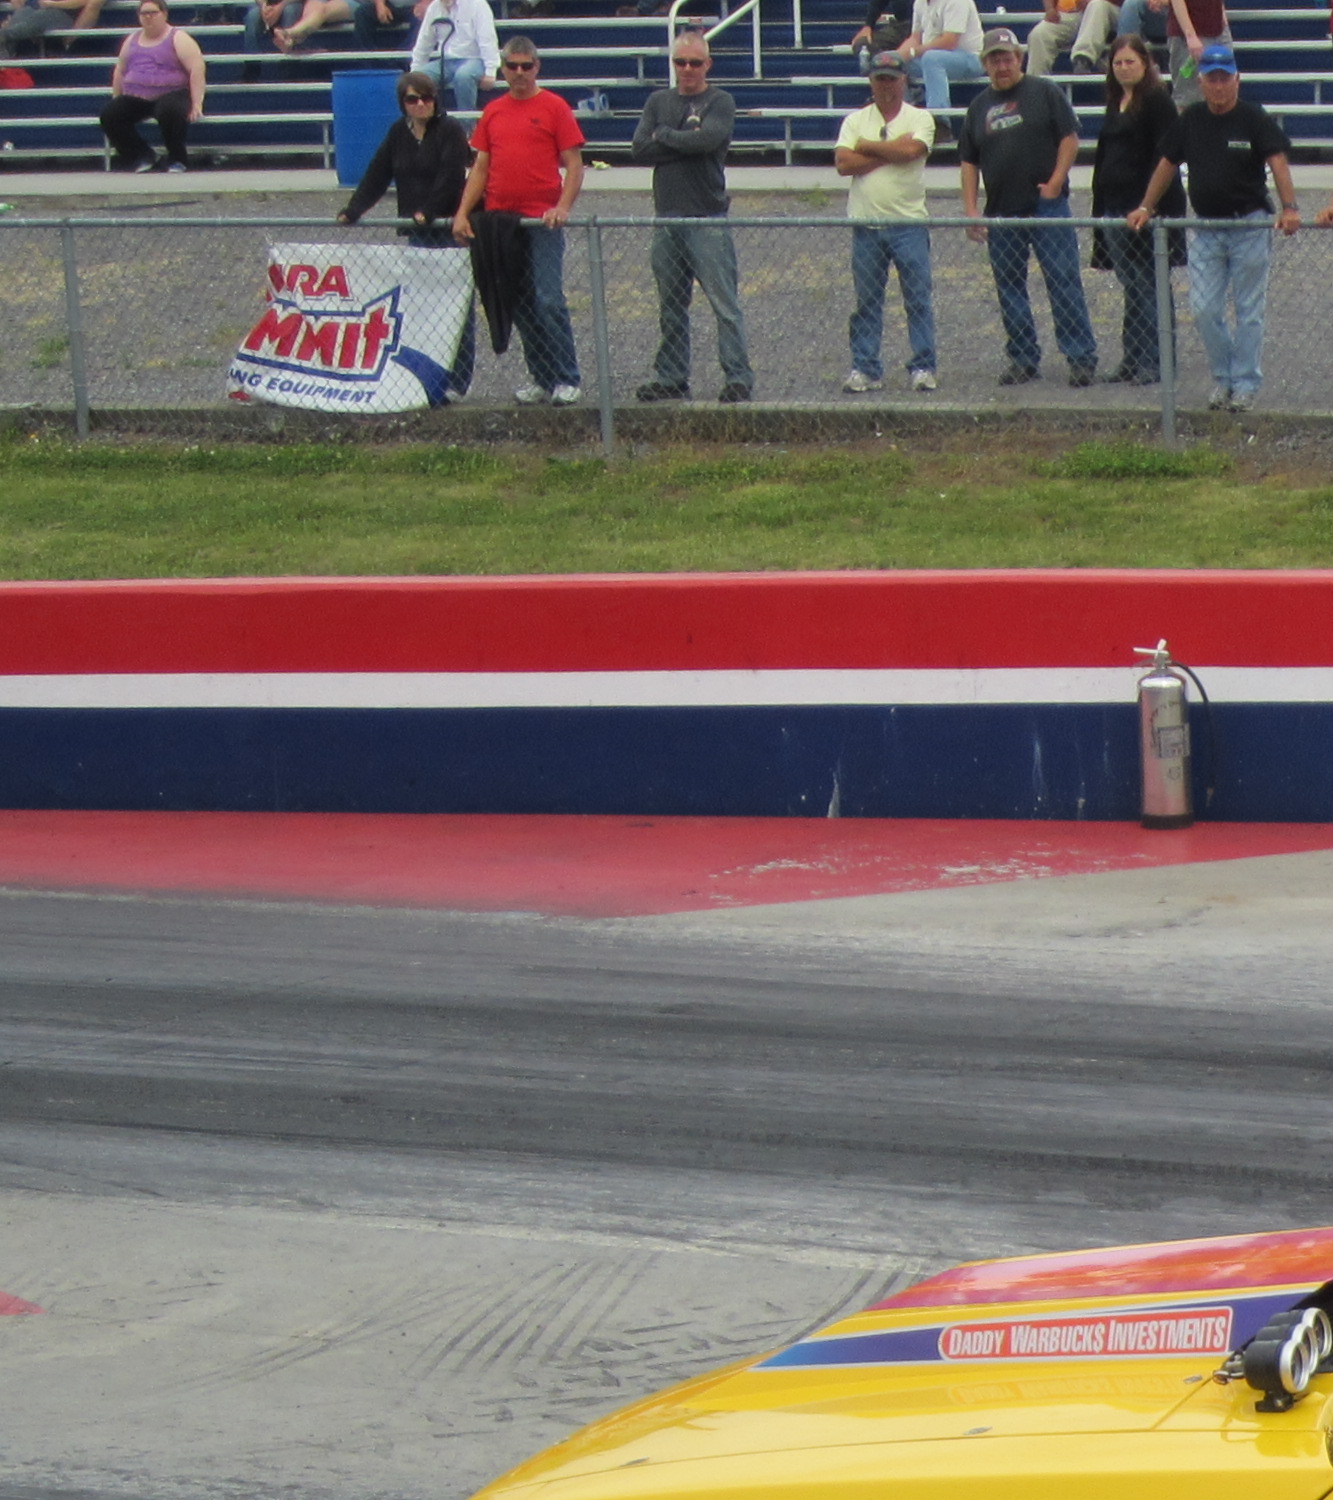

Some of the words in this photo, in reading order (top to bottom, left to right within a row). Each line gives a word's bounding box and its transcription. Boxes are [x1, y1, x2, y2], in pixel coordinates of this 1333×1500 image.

[266, 377, 377, 403] EQUIPMENT
[950, 1329, 1004, 1355] DADDY
[1107, 1315, 1227, 1352] INVESTMENTS
